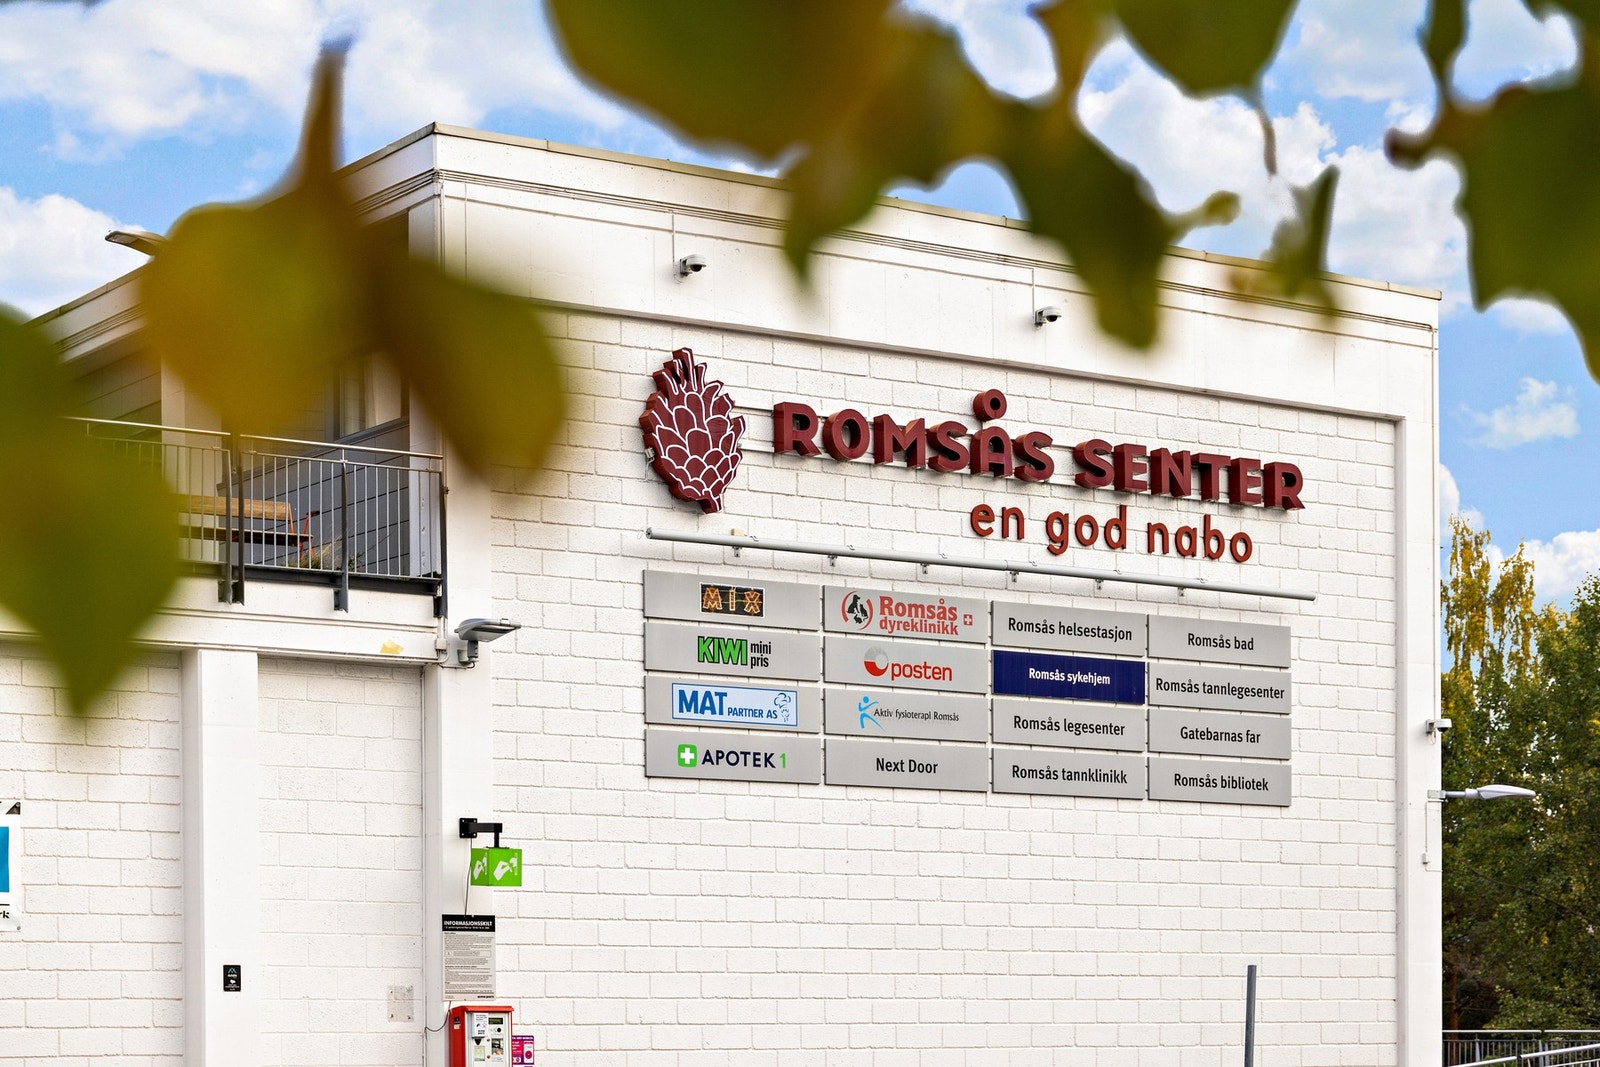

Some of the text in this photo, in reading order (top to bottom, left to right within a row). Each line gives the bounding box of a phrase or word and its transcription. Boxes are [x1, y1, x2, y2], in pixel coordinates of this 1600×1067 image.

[773, 388, 1305, 510] ROMSÅS SENTER
[970, 503, 1254, 564] en god nabo
[702, 586, 762, 614] MIX
[879, 596, 958, 621] Romsås
[879, 615, 959, 636] dyreklinikk
[1008, 617, 1132, 642] Romsås helsestasjon
[698, 636, 748, 666] KIWI
[750, 640, 772, 655] mini
[1187, 633, 1254, 651] Romsås bad
[750, 654, 770, 669] pris
[891, 660, 953, 682] posten
[1028, 668, 1110, 687] Romsås sykehjem
[1156, 678, 1286, 700] Romsås tannlegesenter
[678, 689, 728, 716] MAT
[766, 710, 778, 720] AS
[874, 708, 960, 722] Aktiv fysioterapi Romsås
[1013, 716, 1126, 737] Romsås legesenter
[1180, 726, 1261, 744] Gatebarnas far
[702, 749, 786, 769] APOTEK 1
[876, 757, 938, 774] Next Door
[1012, 765, 1128, 785] Romsås tannklinikk
[1174, 773, 1269, 793] Romsås bibliotek
